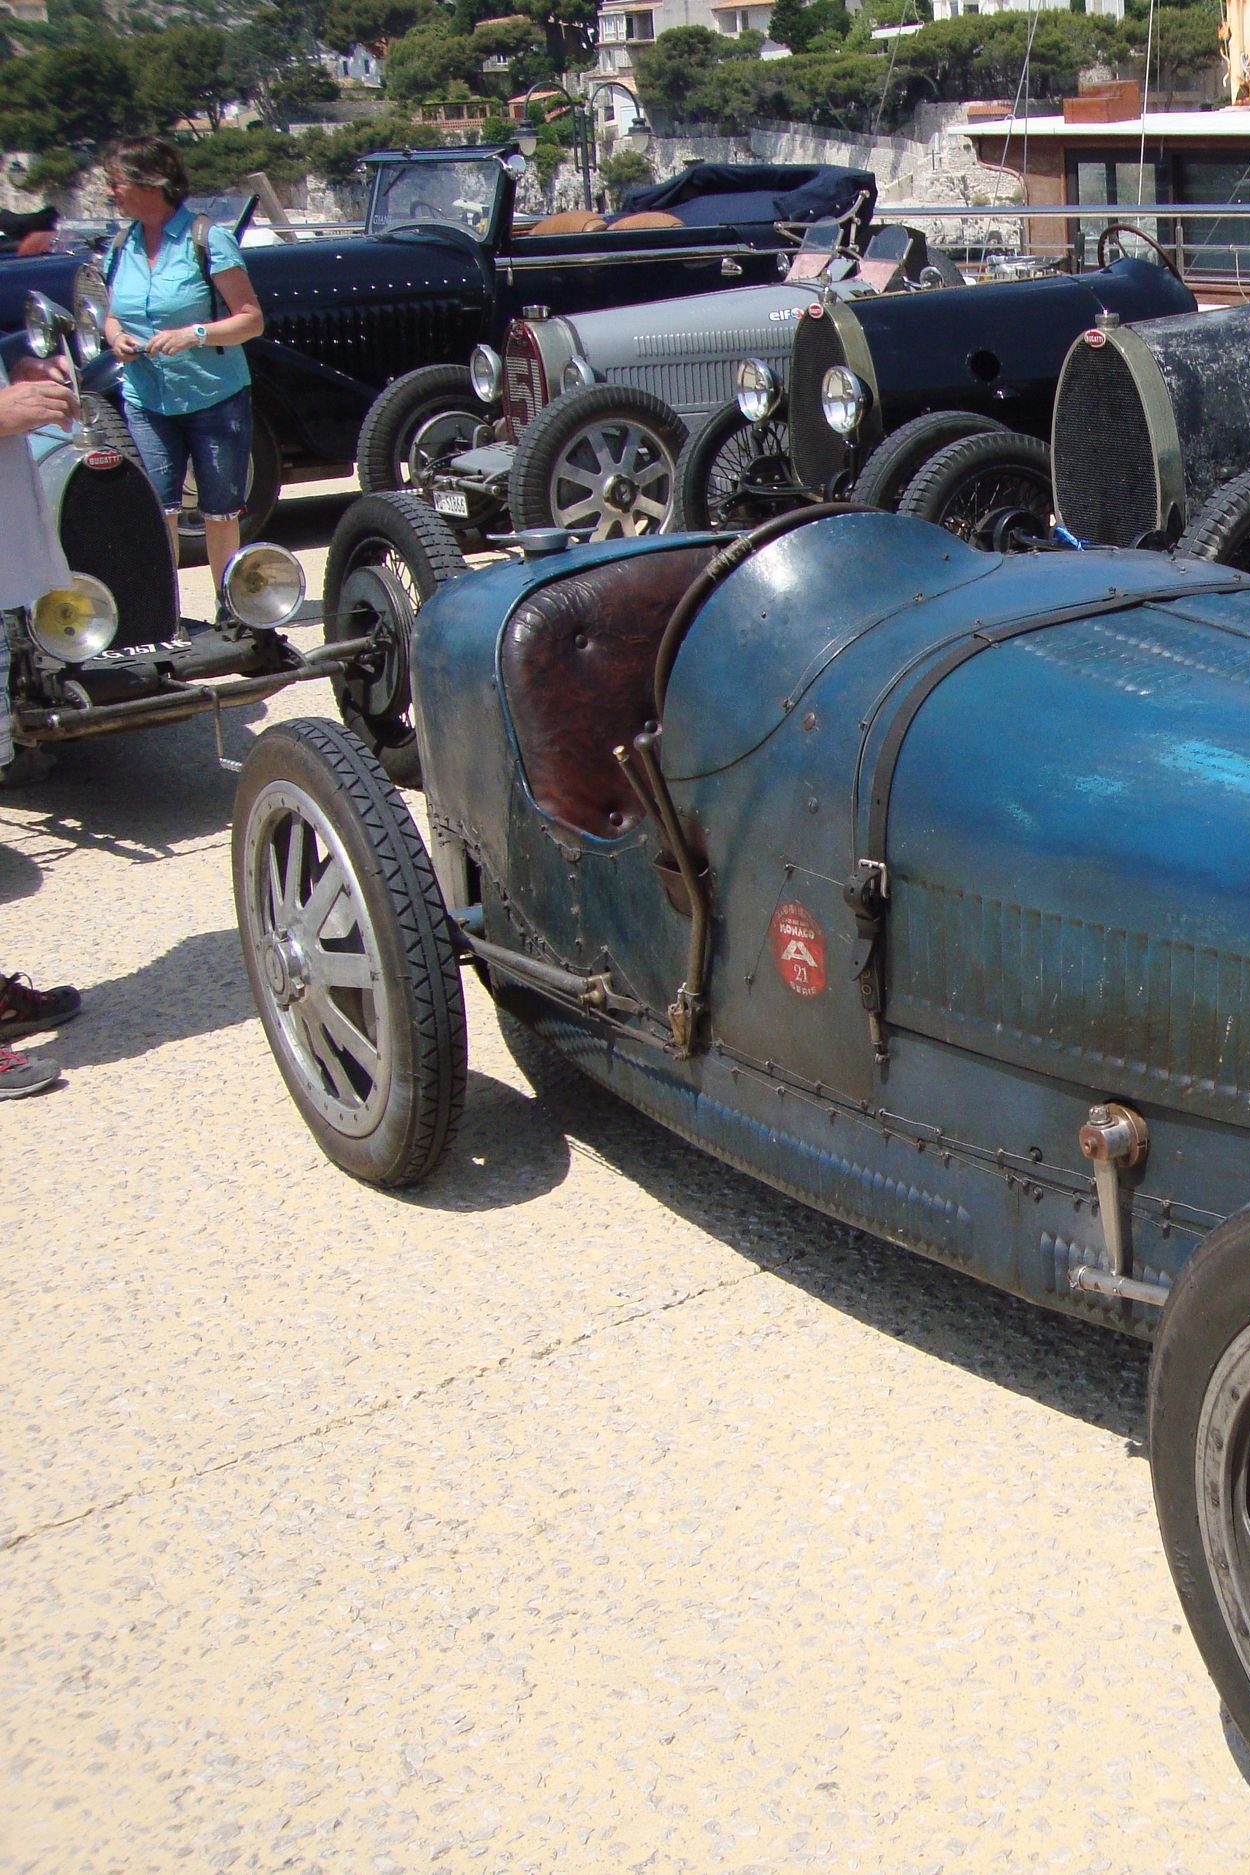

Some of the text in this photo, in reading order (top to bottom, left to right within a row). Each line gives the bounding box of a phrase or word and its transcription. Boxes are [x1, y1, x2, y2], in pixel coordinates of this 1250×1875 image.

[769, 309, 790, 320] elf
[89, 454, 122, 465] BUGATTI
[781, 939, 818, 968] A
[793, 965, 808, 983] 21
